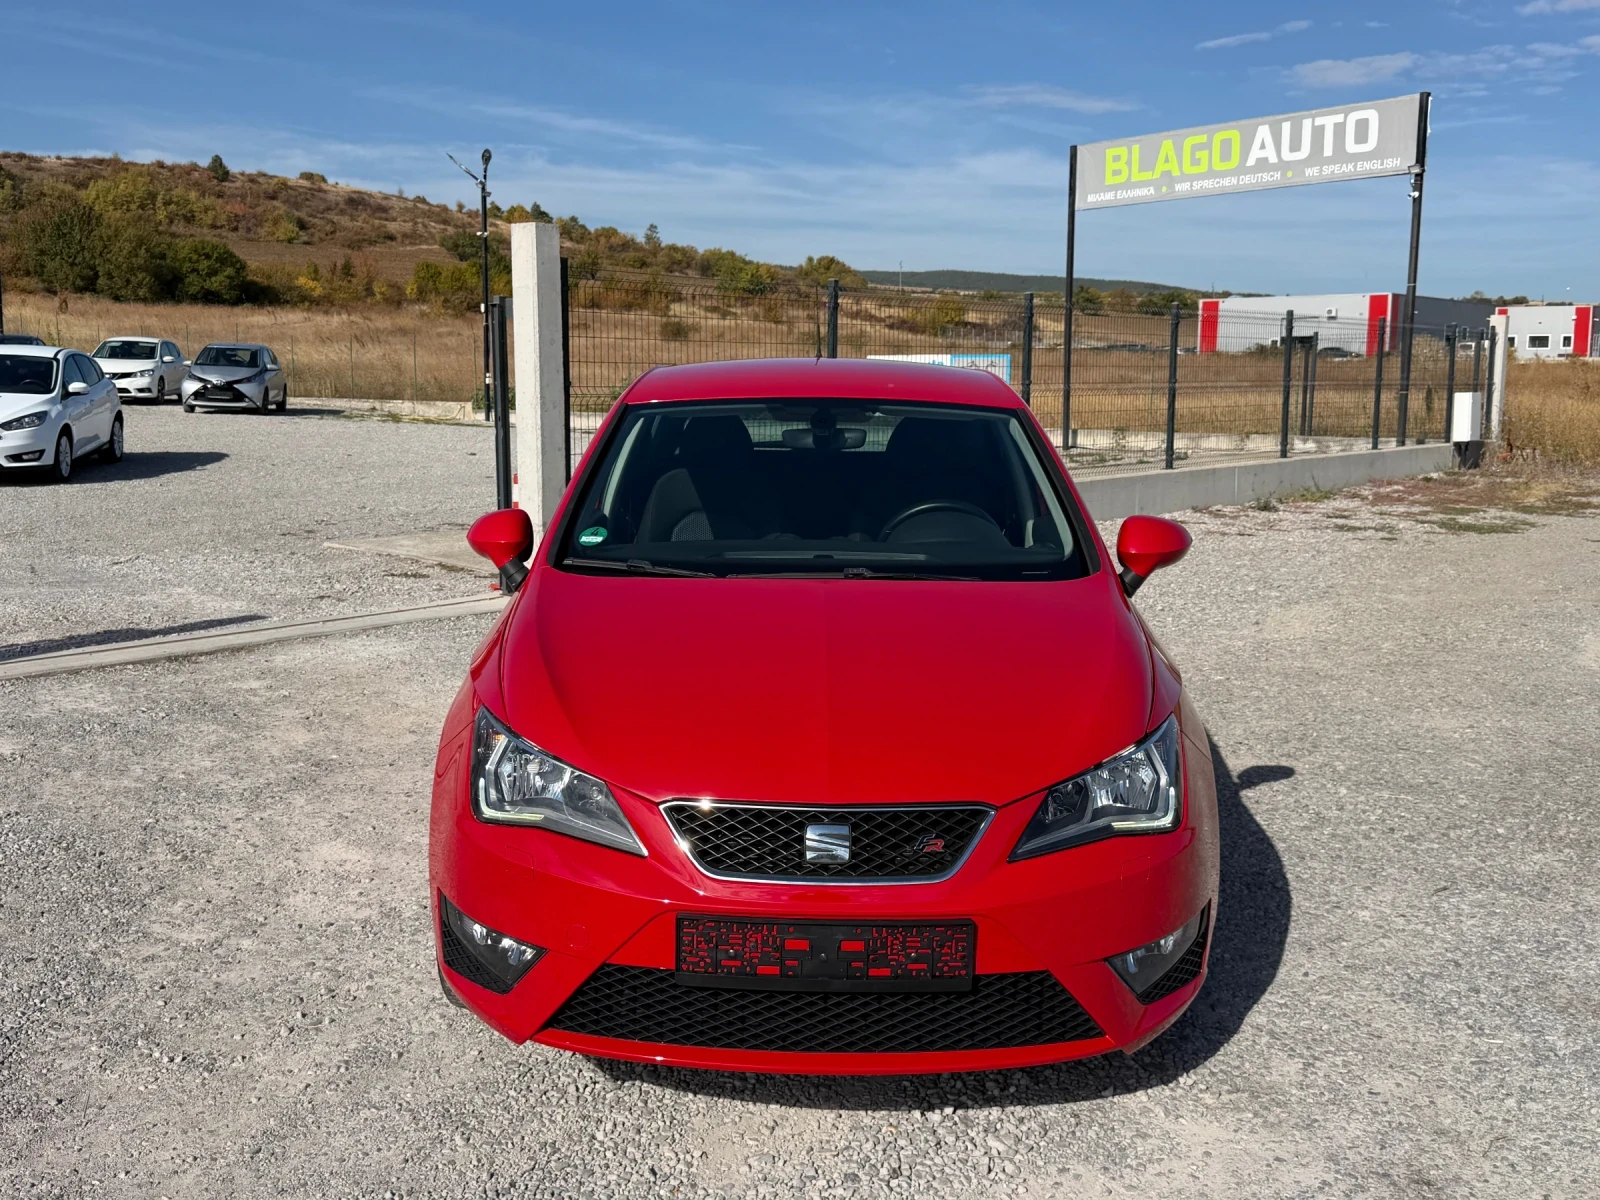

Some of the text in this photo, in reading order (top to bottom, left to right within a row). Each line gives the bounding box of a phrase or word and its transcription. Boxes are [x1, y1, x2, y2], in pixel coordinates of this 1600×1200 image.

[1105, 108, 1379, 186] BLAGO AUTO
[1304, 157, 1401, 177] WE SPEAK ENGLISH
[1174, 171, 1281, 192] WIR SPRECHEN DEUTSCH
